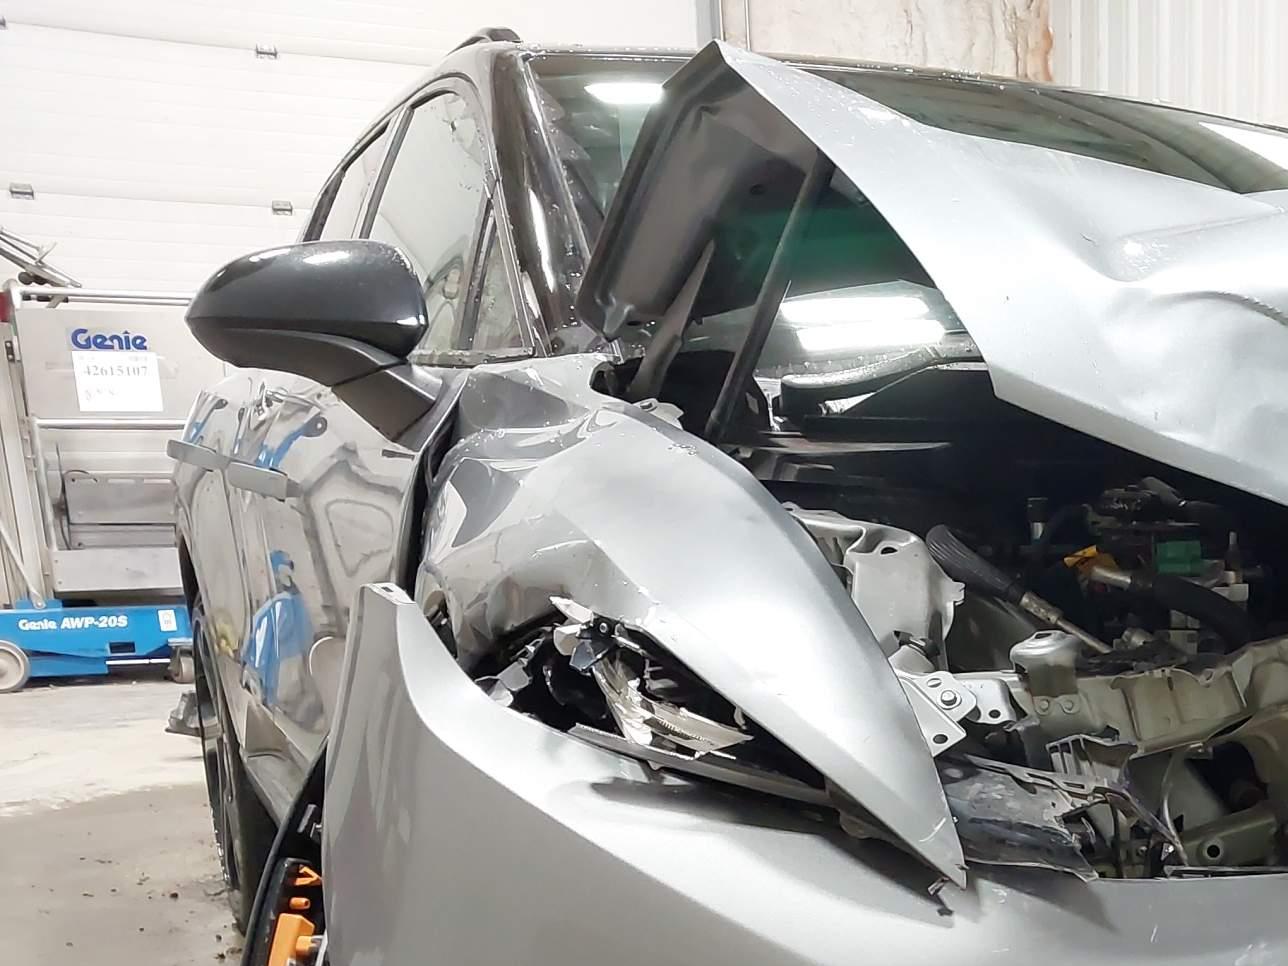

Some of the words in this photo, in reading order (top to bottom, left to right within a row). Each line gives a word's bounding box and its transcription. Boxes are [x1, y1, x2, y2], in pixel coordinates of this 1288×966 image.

[71, 328, 147, 350] Genie
[18, 618, 57, 631] Genie
[60, 615, 128, 629] AWP-20S
